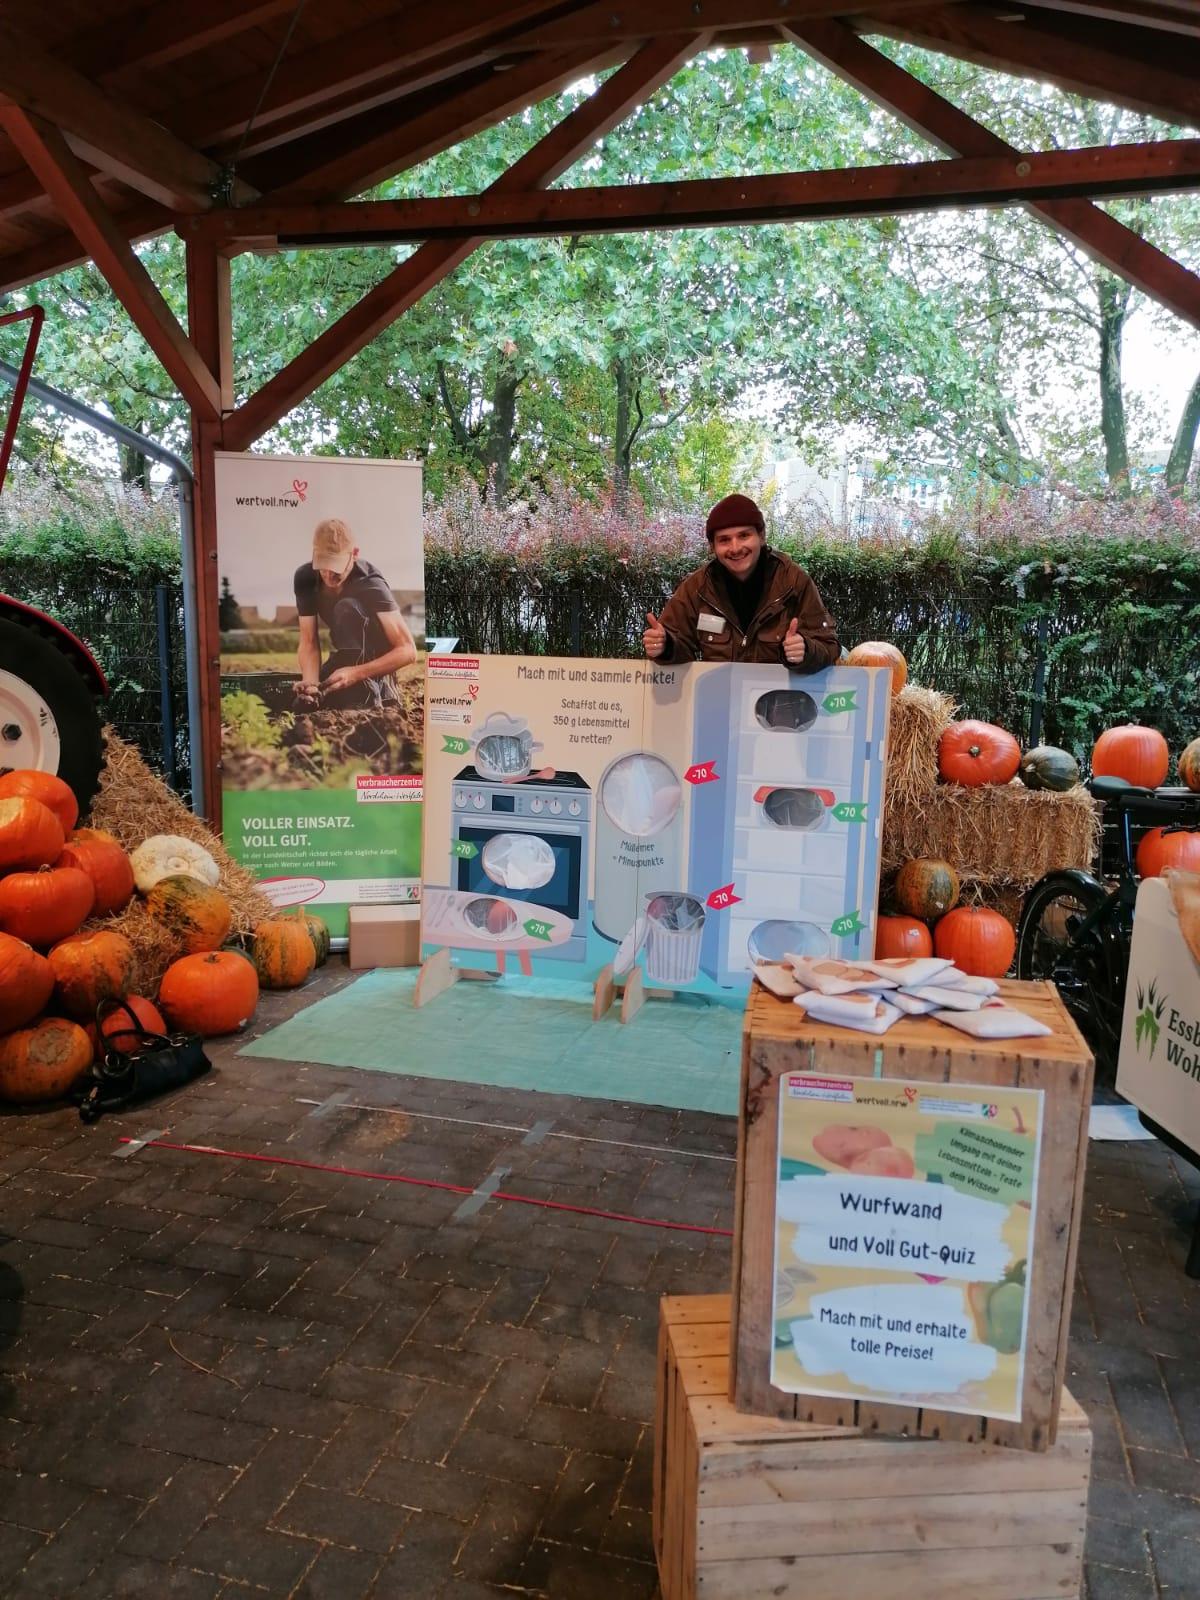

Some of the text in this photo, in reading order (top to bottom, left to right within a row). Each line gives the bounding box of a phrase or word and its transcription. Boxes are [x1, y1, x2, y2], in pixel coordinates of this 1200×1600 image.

[235, 496, 299, 508] wertvoll.nrw
[517, 665, 675, 685] Mach mit und sammle Punkte!
[430, 697, 472, 706] wertvoll.nrw
[561, 698, 623, 713] Schaffst du es,
[830, 697, 846, 708] +70
[553, 715, 630, 729] 350 g Lebensmittel
[568, 734, 612, 745] zu retten?
[450, 741, 464, 751] +70
[692, 768, 707, 779] -70
[358, 777, 423, 787] verbraucherzentra
[839, 807, 856, 818] +70
[242, 816, 355, 830] VOLLER EINSATZ.
[242, 834, 312, 847] VOLL GUT.
[456, 844, 471, 855] +70
[714, 892, 728, 904] -70
[530, 923, 545, 935] +70
[838, 919, 853, 931] +70
[856, 1096, 908, 1107] wertvoll.nrw
[950, 1138, 1022, 1173] Umgang mit deinen
[938, 1149, 992, 1178] Lebensmitteln
[1000, 1173, 1023, 1189] Teste
[949, 1170, 966, 1182] dein
[840, 1192, 943, 1221] Wurfwand
[829, 1235, 977, 1265] und Voll Gut-Quiz
[820, 1308, 968, 1339] Mach mit und erhalte
[850, 1337, 934, 1361] tolle Preise!
